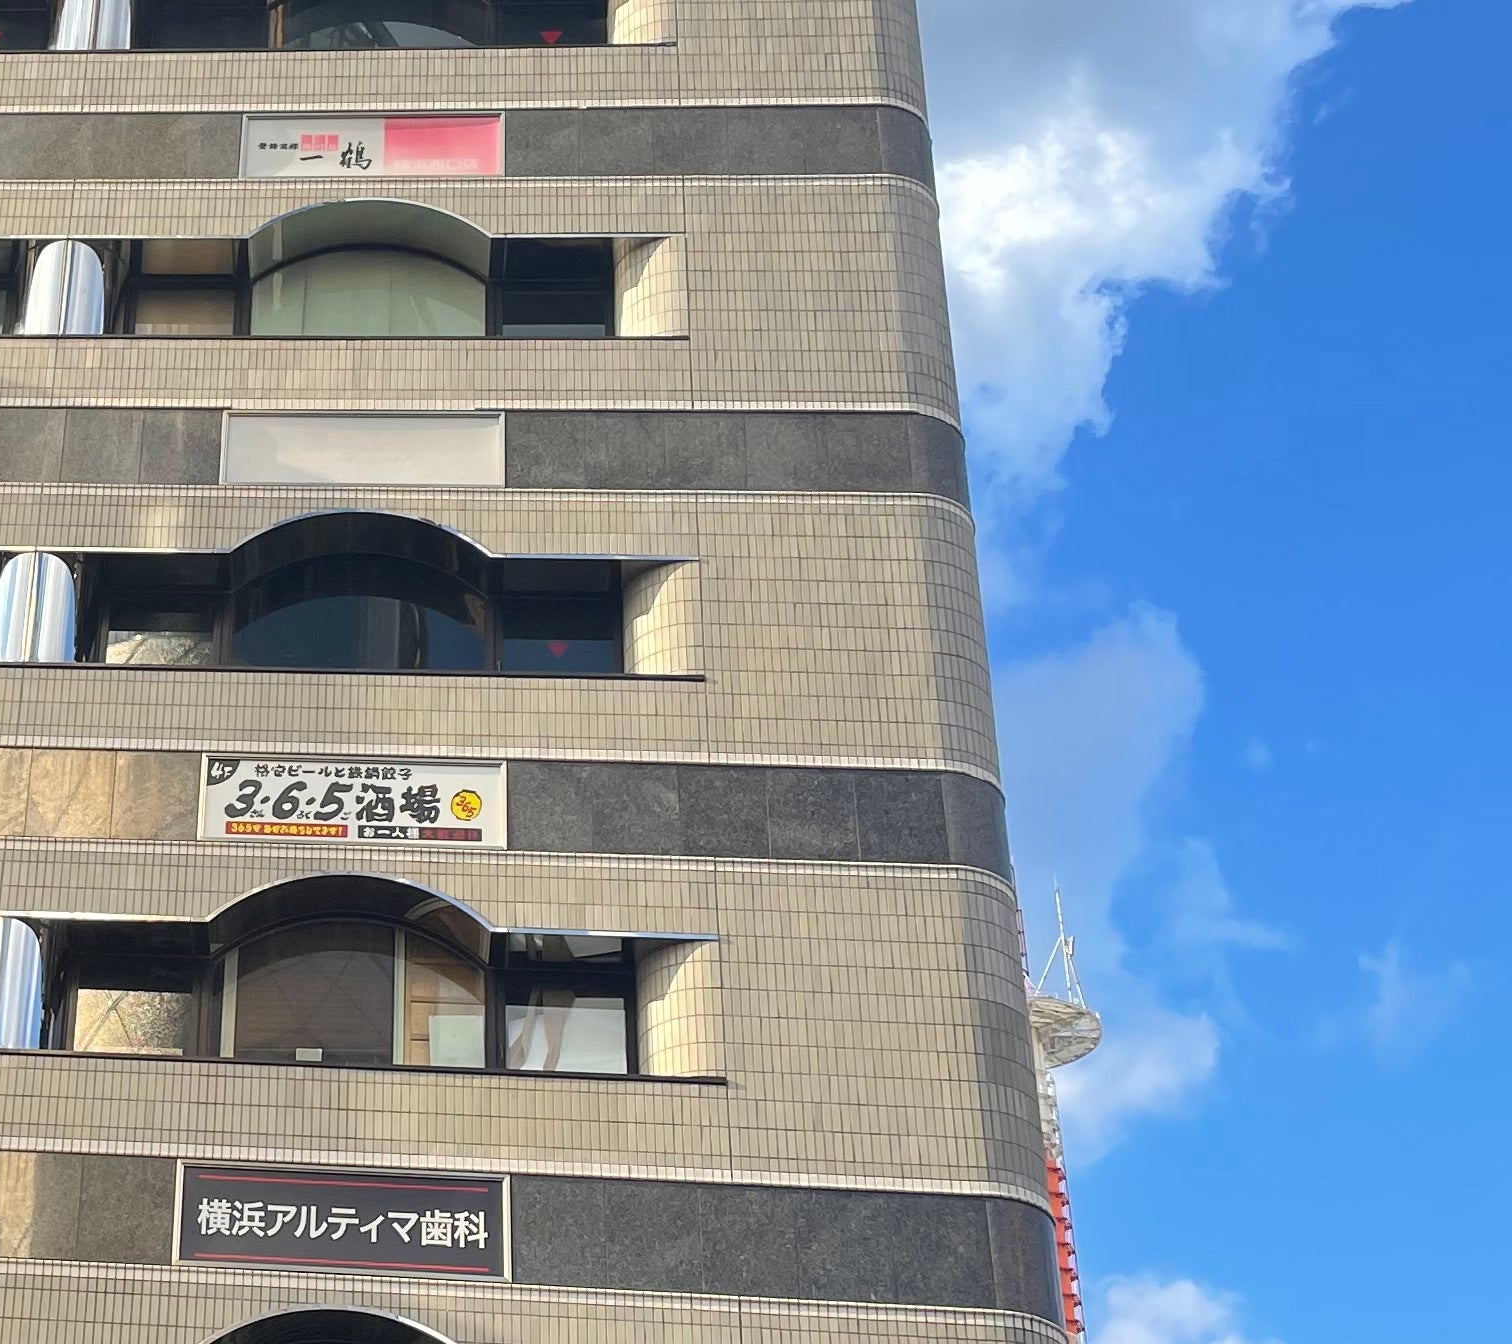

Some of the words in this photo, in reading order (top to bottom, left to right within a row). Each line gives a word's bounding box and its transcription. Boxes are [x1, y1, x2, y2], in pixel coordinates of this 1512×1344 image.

[210, 760, 234, 780] 4F
[197, 1196, 489, 1249] 横浜アルティマ歯科
